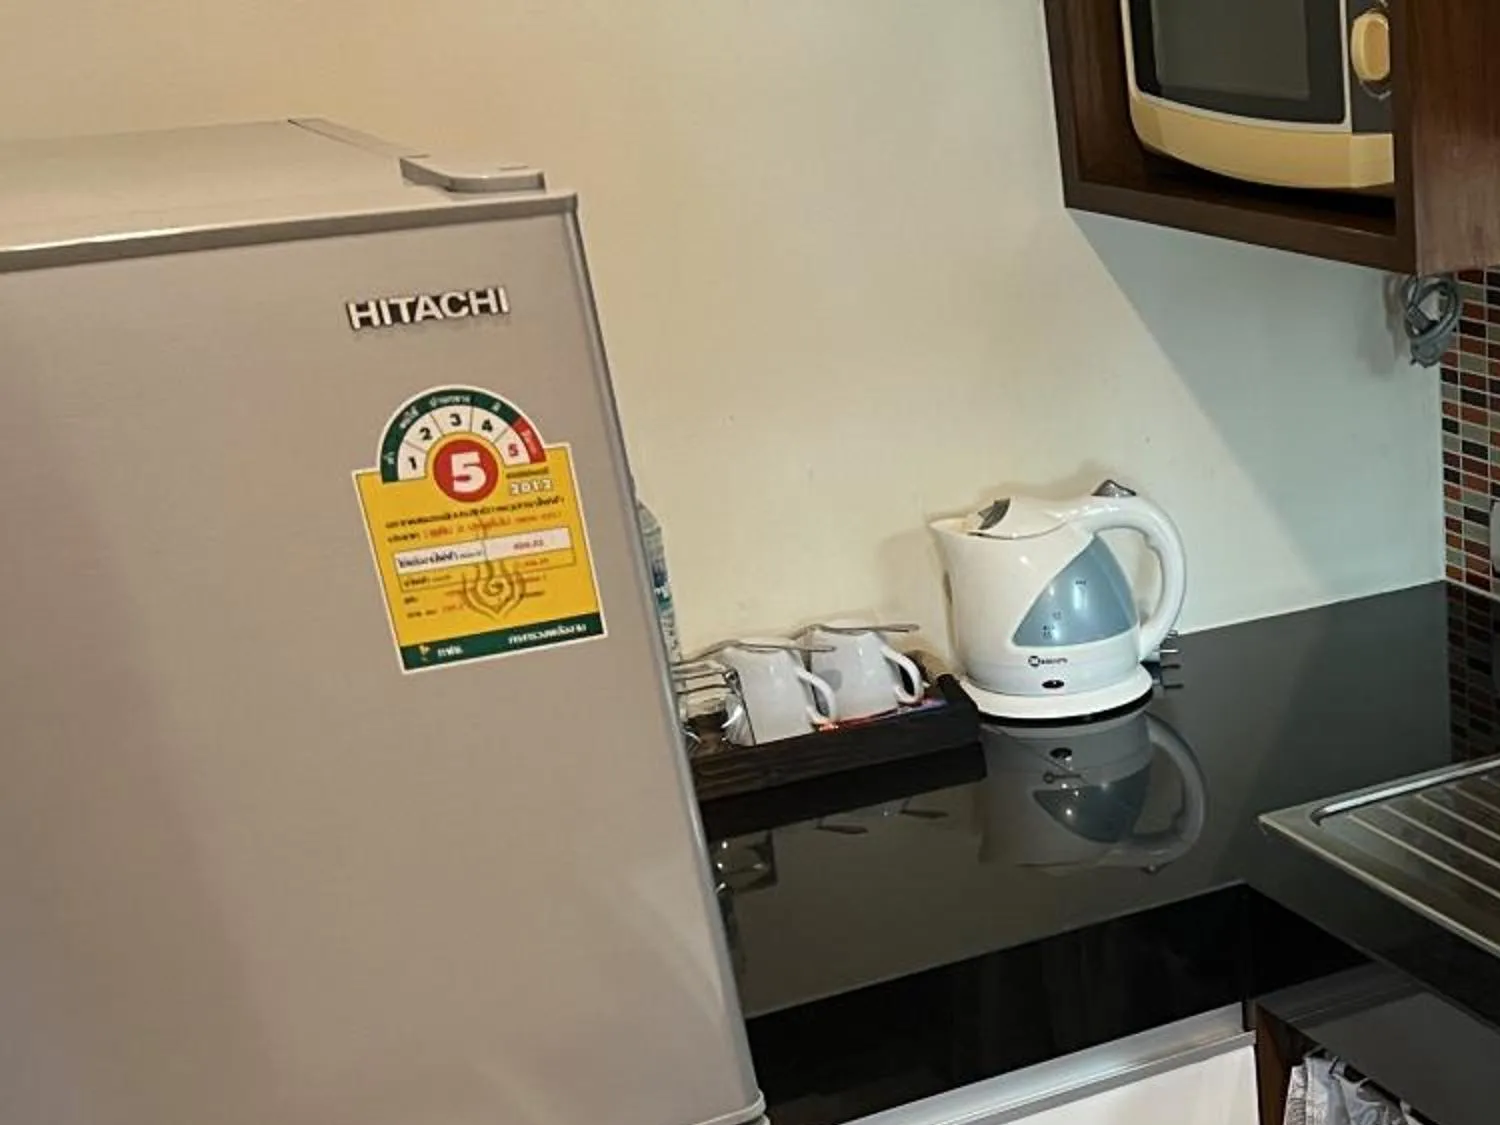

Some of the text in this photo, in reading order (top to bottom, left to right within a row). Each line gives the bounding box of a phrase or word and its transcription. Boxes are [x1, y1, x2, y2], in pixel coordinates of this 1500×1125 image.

[346, 287, 511, 330] HITACHI
[407, 455, 417, 470] 1
[419, 427, 432, 441] 2
[450, 413, 461, 427] 3
[481, 420, 493, 433] 4
[508, 443, 519, 457] 5
[451, 451, 487, 494] 5
